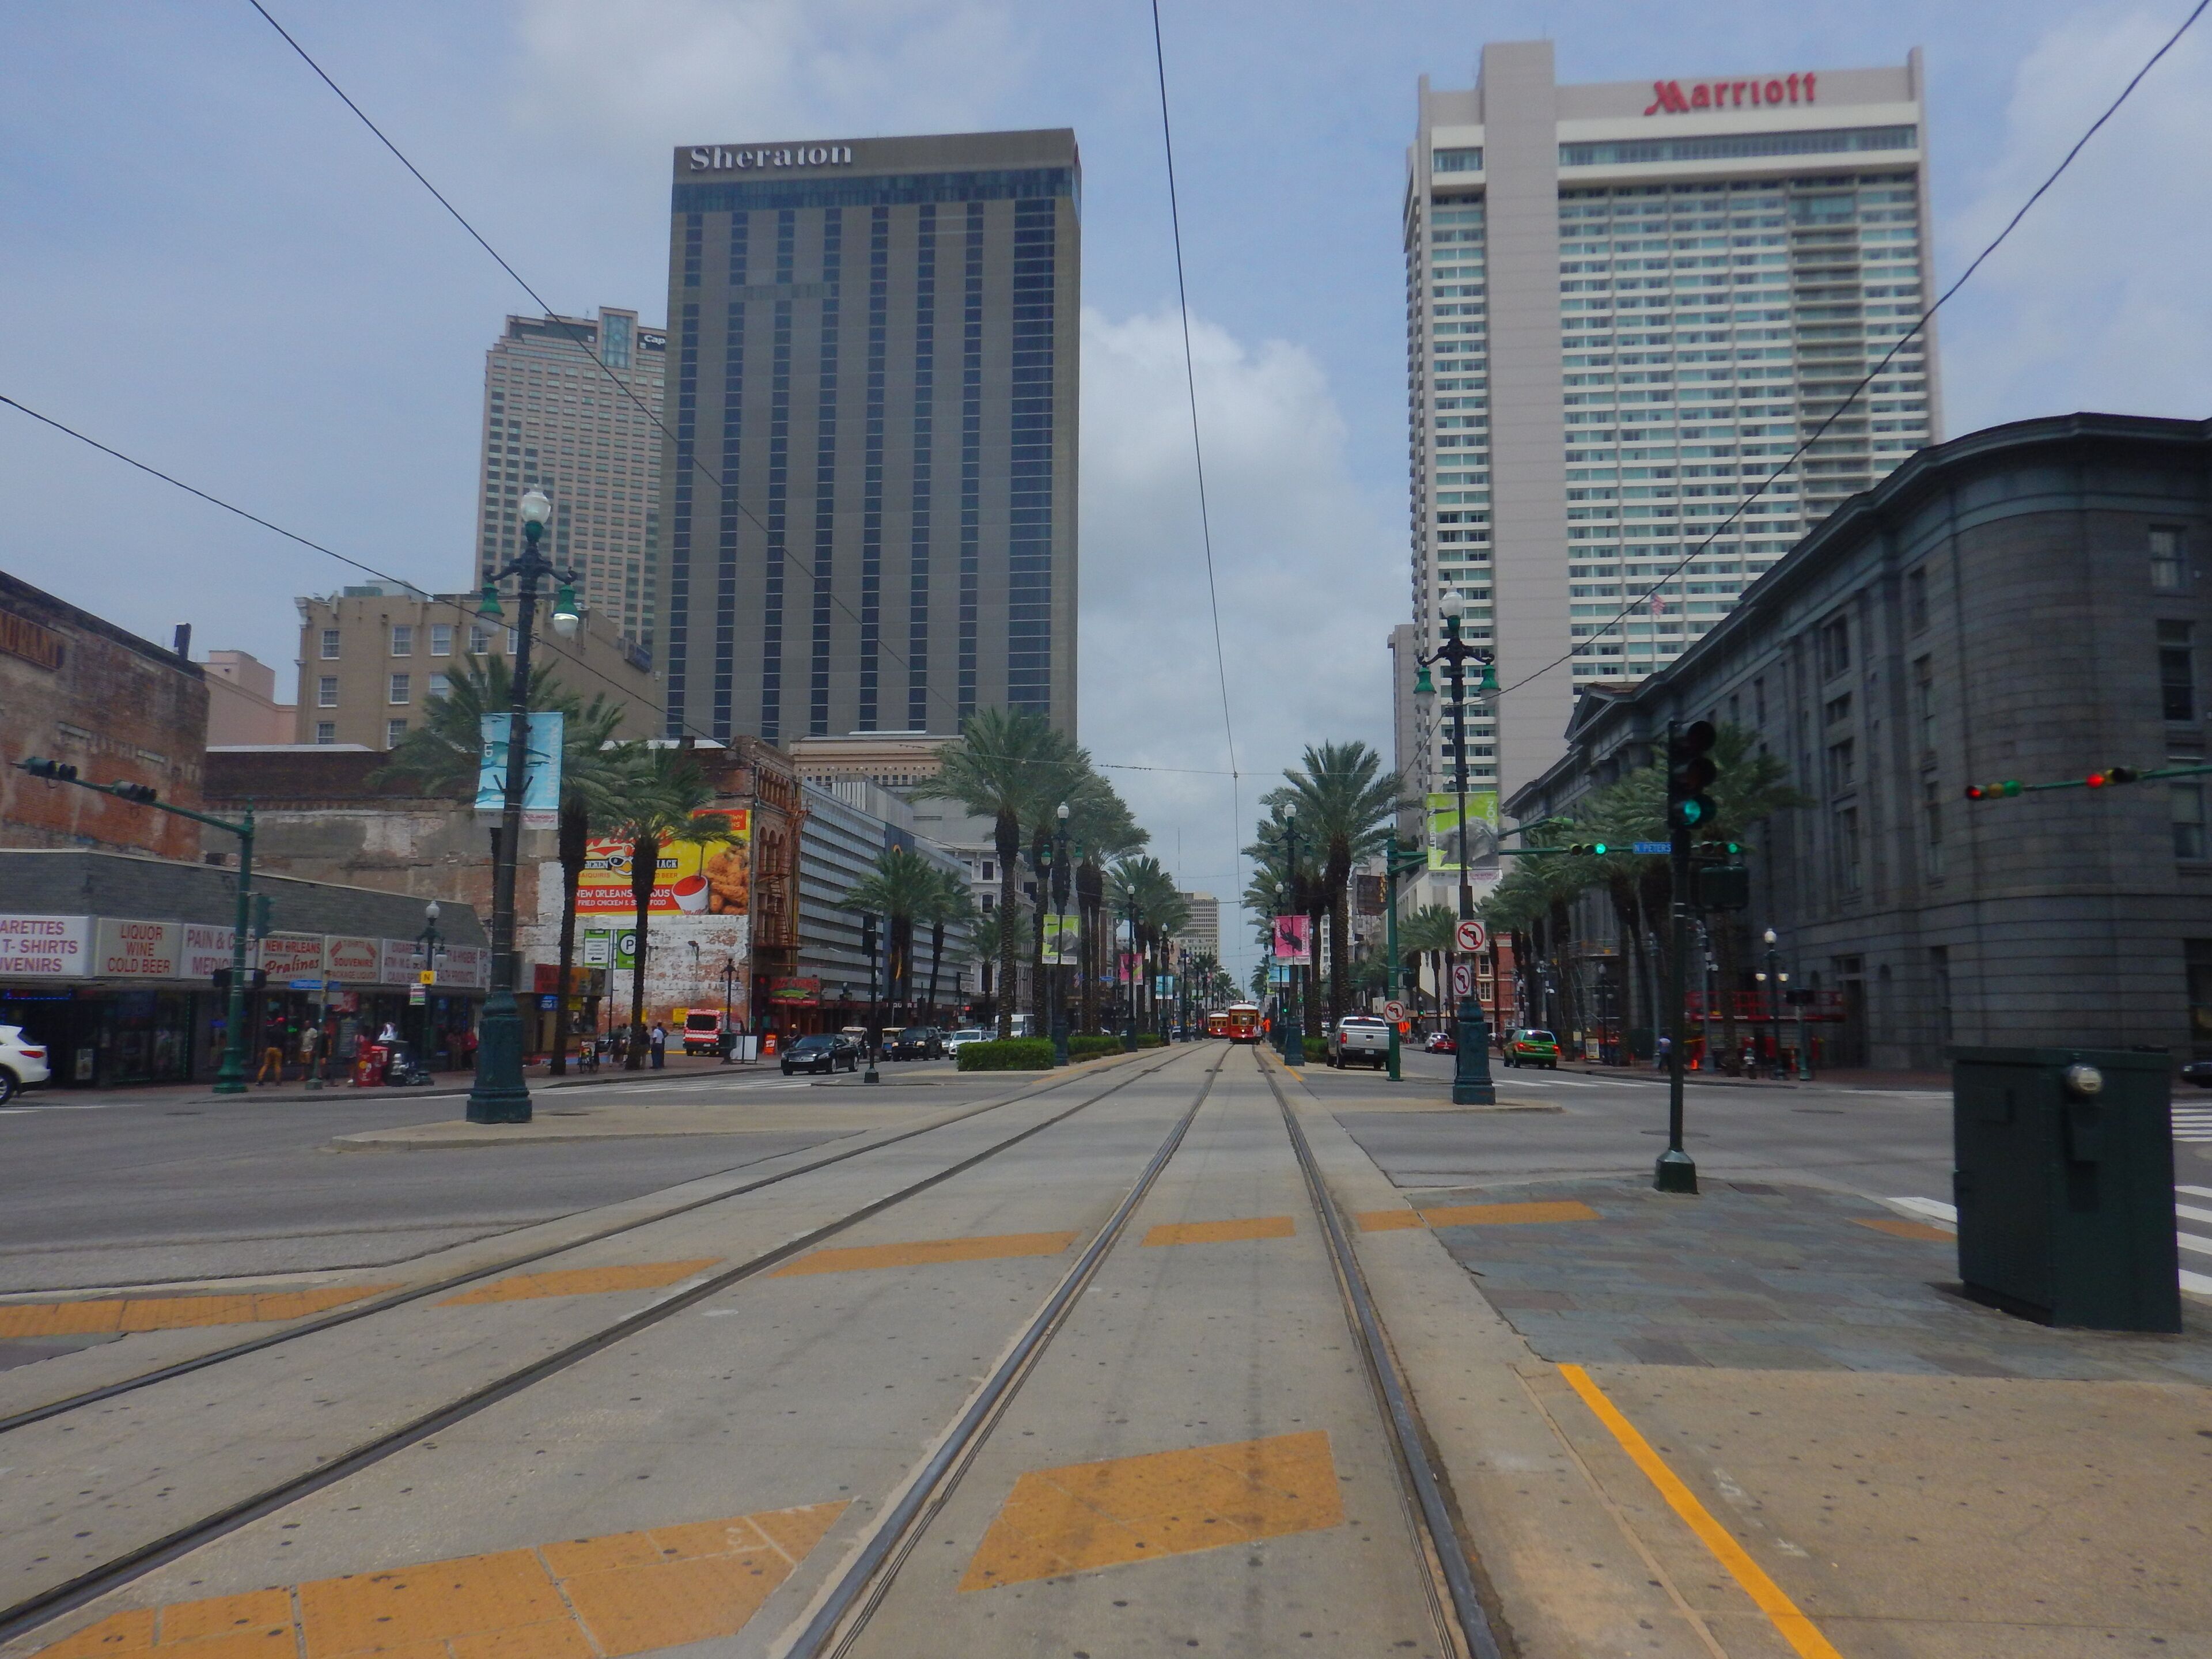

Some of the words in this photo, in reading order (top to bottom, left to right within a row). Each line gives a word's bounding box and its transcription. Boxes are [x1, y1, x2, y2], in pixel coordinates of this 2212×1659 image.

[1643, 72, 1817, 116] Marriott
[690, 146, 852, 171] Sheraton
[644, 335, 666, 345] Cap
[595, 889, 633, 898] ORLEANS
[0, 920, 65, 935] ARETTES
[120, 924, 163, 941] LIQUOR
[19, 939, 78, 954] SHIRTS
[188, 929, 213, 949] PAIN
[626, 940, 634, 950] P
[126, 942, 155, 957] WINE
[266, 940, 282, 952] NEW
[285, 941, 321, 954] ORLEANS
[108, 957, 138, 972] COLD
[142, 959, 171, 974] BEER
[265, 954, 320, 975] Pralines
[334, 957, 373, 968] SOUVENIRS
[423, 973, 431, 981] N
